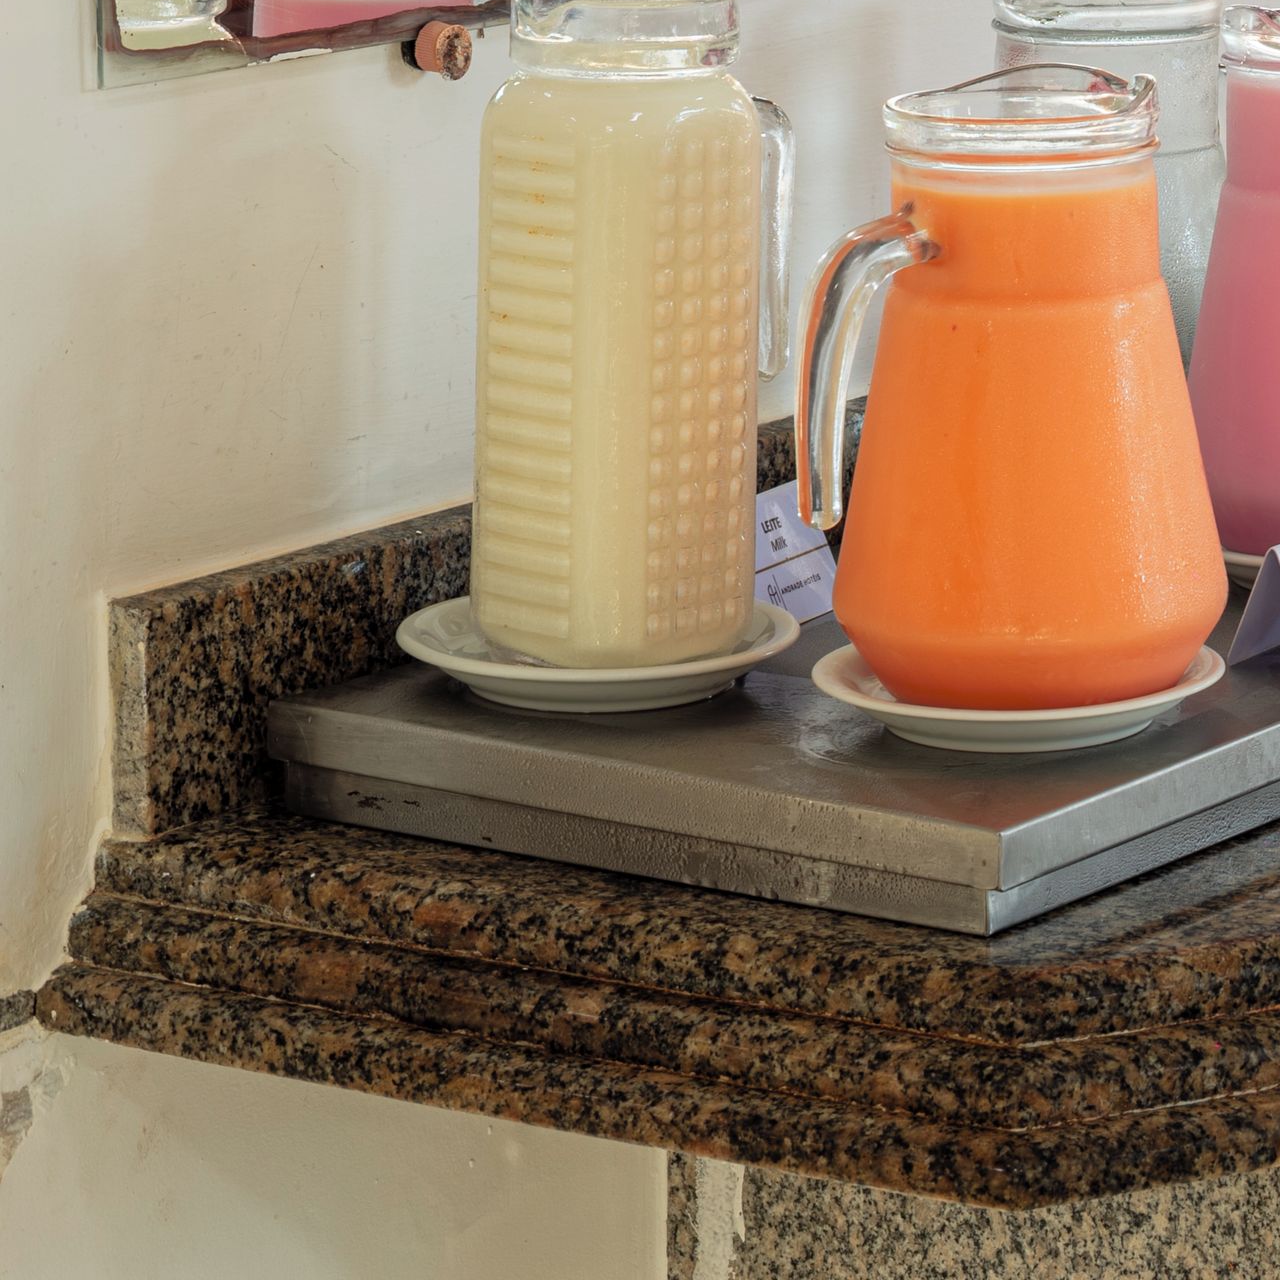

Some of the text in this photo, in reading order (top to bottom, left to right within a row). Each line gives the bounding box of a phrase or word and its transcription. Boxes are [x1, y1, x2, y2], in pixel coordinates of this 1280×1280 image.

[761, 517, 782, 533] LEITE
[770, 536, 788, 552] Milk
[781, 580, 804, 595] ANDRADE
